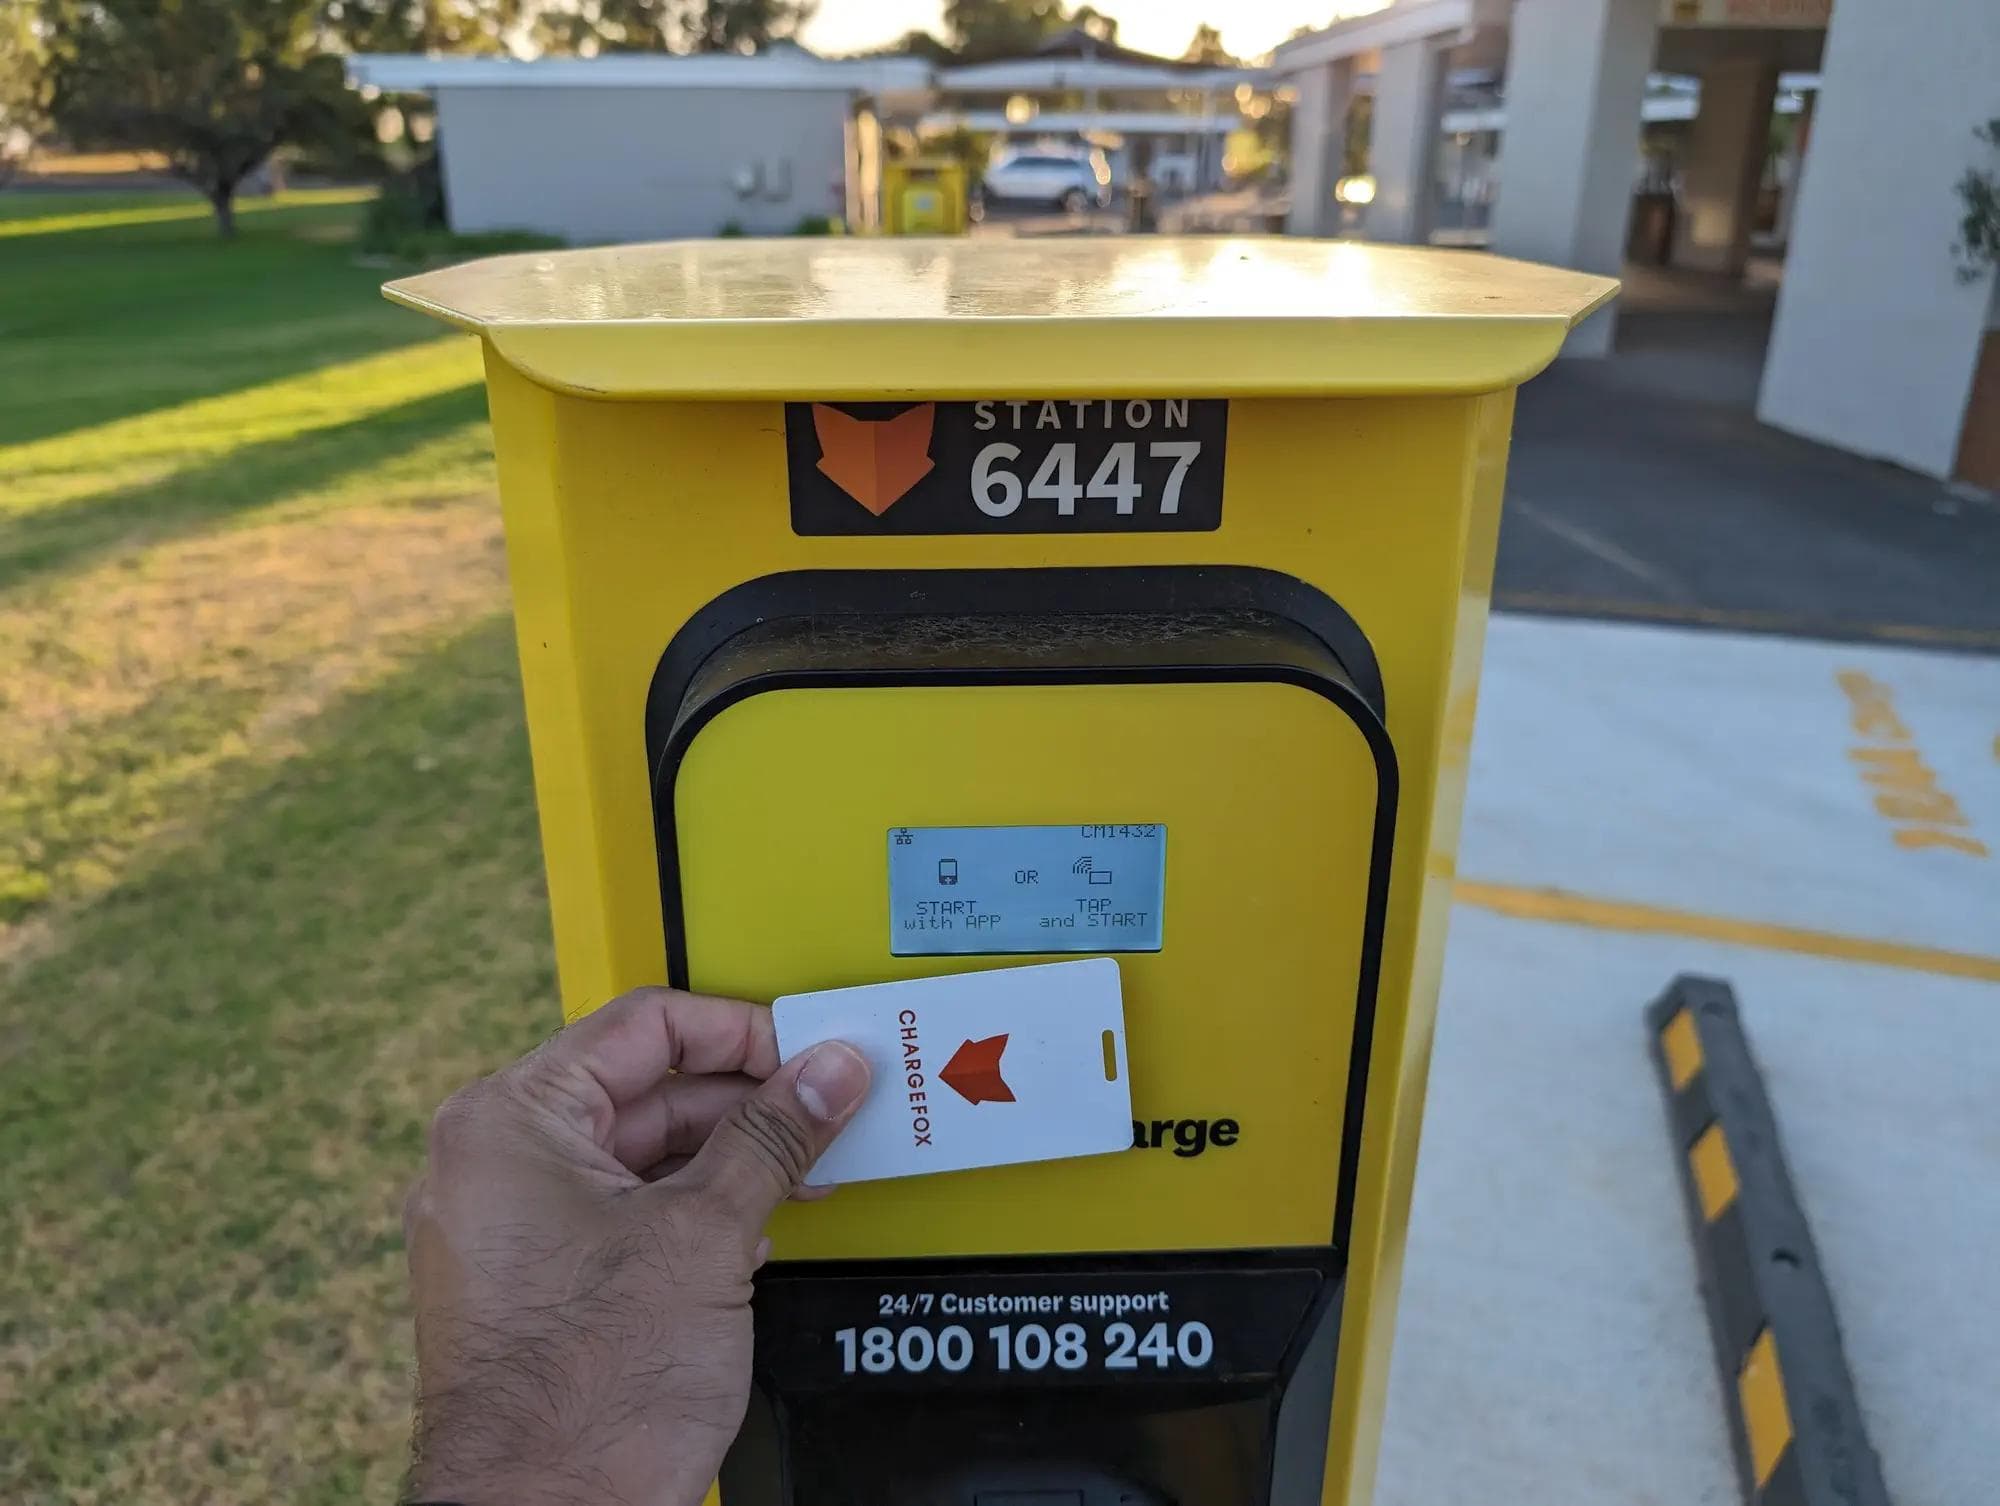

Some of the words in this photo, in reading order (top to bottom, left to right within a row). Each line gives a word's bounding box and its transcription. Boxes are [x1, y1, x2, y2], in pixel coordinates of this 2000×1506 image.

[973, 400, 1189, 430] STATION
[970, 441, 1201, 518] 6447
[1081, 824, 1156, 838] CM1432
[1014, 870, 1039, 884] OR
[916, 900, 977, 915] START
[1075, 899, 1111, 913] TAP
[904, 916, 952, 930] with
[966, 915, 1001, 929] APP
[1039, 914, 1075, 928] and
[1087, 912, 1148, 927] START
[898, 1009, 932, 1147] CHARGEFOX
[878, 1293, 934, 1316] 24/7
[940, 1292, 1063, 1314] Customer
[1070, 1291, 1169, 1317] support
[835, 1325, 974, 1373] 1800
[989, 1323, 1088, 1371] 108
[1104, 1321, 1213, 1370] 240
